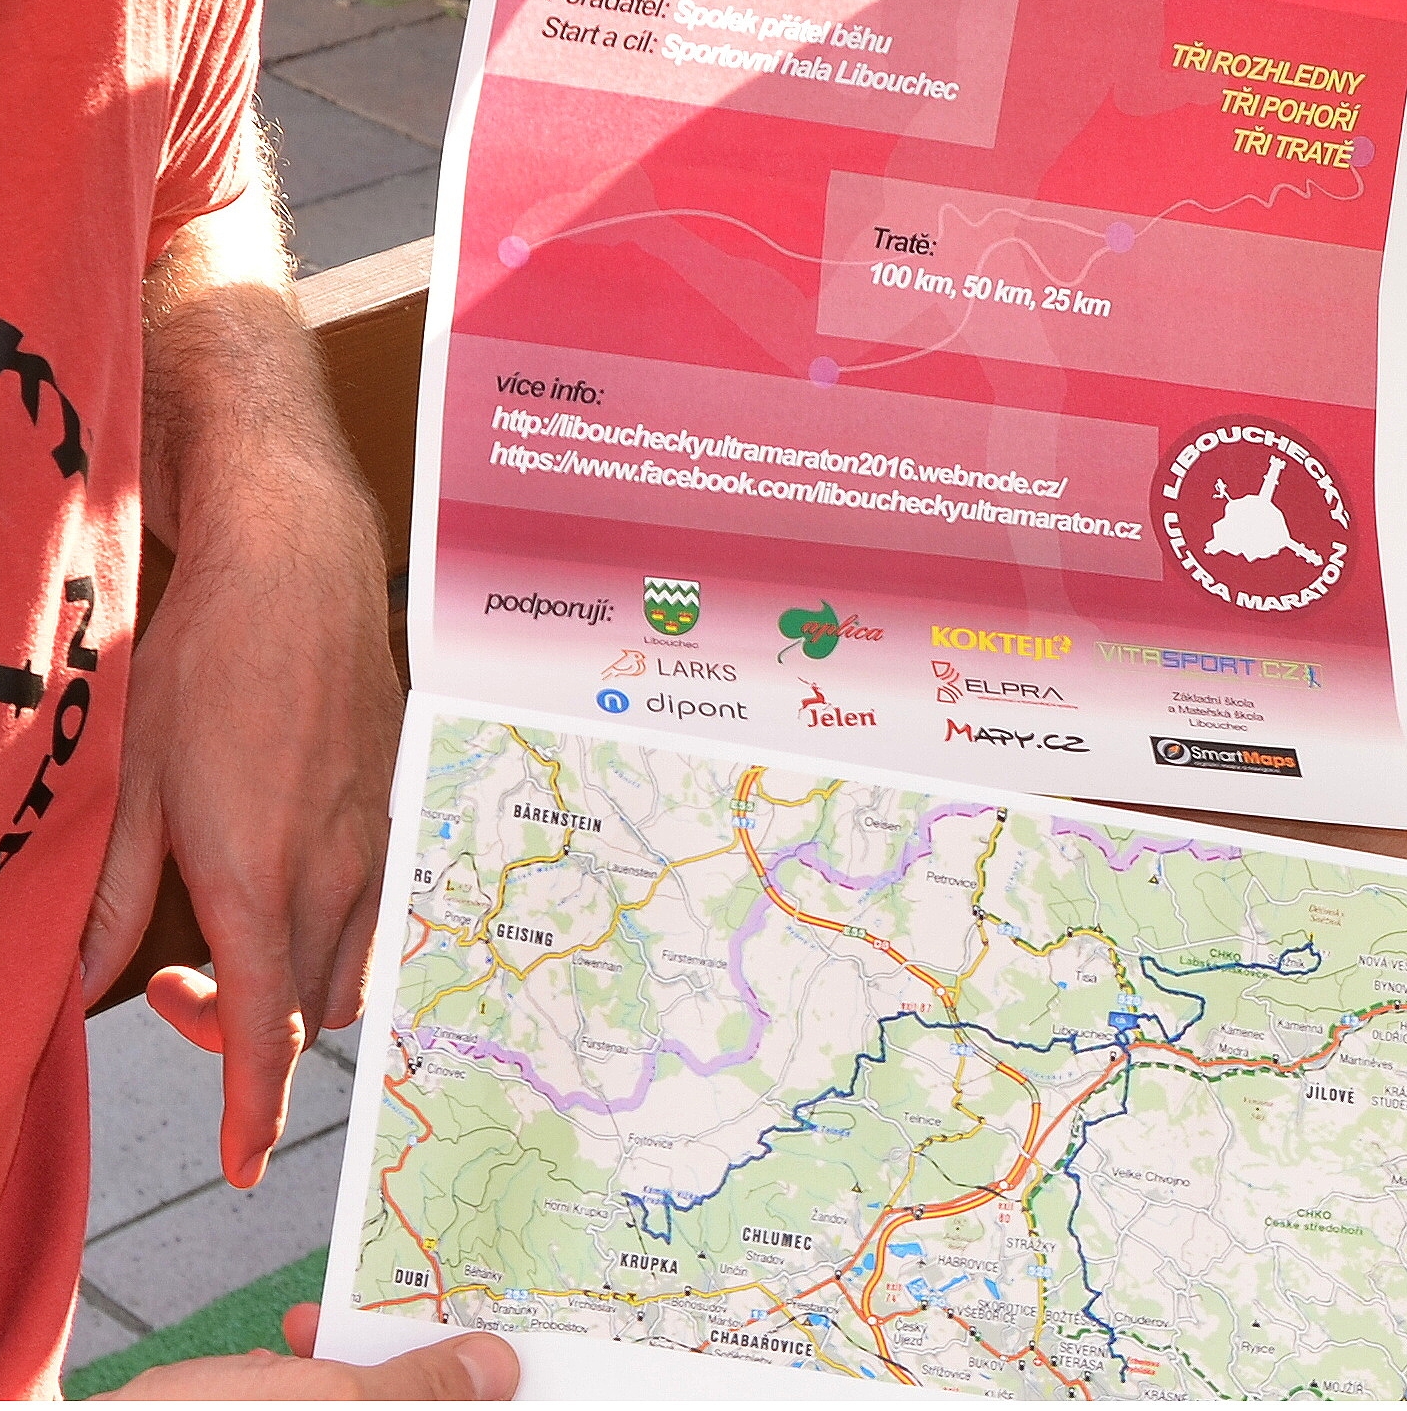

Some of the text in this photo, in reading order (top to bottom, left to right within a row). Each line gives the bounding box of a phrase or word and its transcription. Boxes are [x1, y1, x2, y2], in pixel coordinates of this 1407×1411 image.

[758, 12, 829, 46] přátel
[829, 25, 894, 55] běhu
[541, 16, 961, 102] Start a cíl: Sportovní hala Libouchec
[1171, 43, 1367, 97] TŘI ROZHLEDNY
[1219, 89, 1361, 133] TŘI POHOŘÍ
[1231, 128, 1355, 170] TŘI TRATĚ
[873, 227, 939, 257] Tratě:
[868, 261, 1112, 319] 100 km, 50 km, 25 km
[495, 371, 605, 406] více info:
[491, 405, 1068, 501] http://liboucheckyultramaraton2016.webnode.cz/
[488, 441, 1144, 542] https://www.facebook.com/liboucheckyultramaraton.cz
[1162, 425, 1351, 530] LIBOUCHECKÝ
[1162, 511, 1232, 603] ULTRA
[1235, 540, 1349, 612] MARATON
[484, 591, 616, 626] podporují:
[930, 625, 1062, 662] KOKTEJL
[657, 657, 738, 682] LARKS
[646, 692, 749, 721] dipont
[1190, 745, 1297, 769] SmartMaps
[513, 802, 602, 833] BÄRENSTEIN
[925, 870, 978, 889] Petrovice
[496, 922, 555, 948] GEISING
[1304, 1081, 1356, 1106] JÍLOVÉ
[742, 1225, 813, 1252] CHLUMEC
[394, 1268, 430, 1288] DUBÍ
[620, 1252, 679, 1275] KRUPKA
[710, 1327, 814, 1358] CHABAŘOVICE
